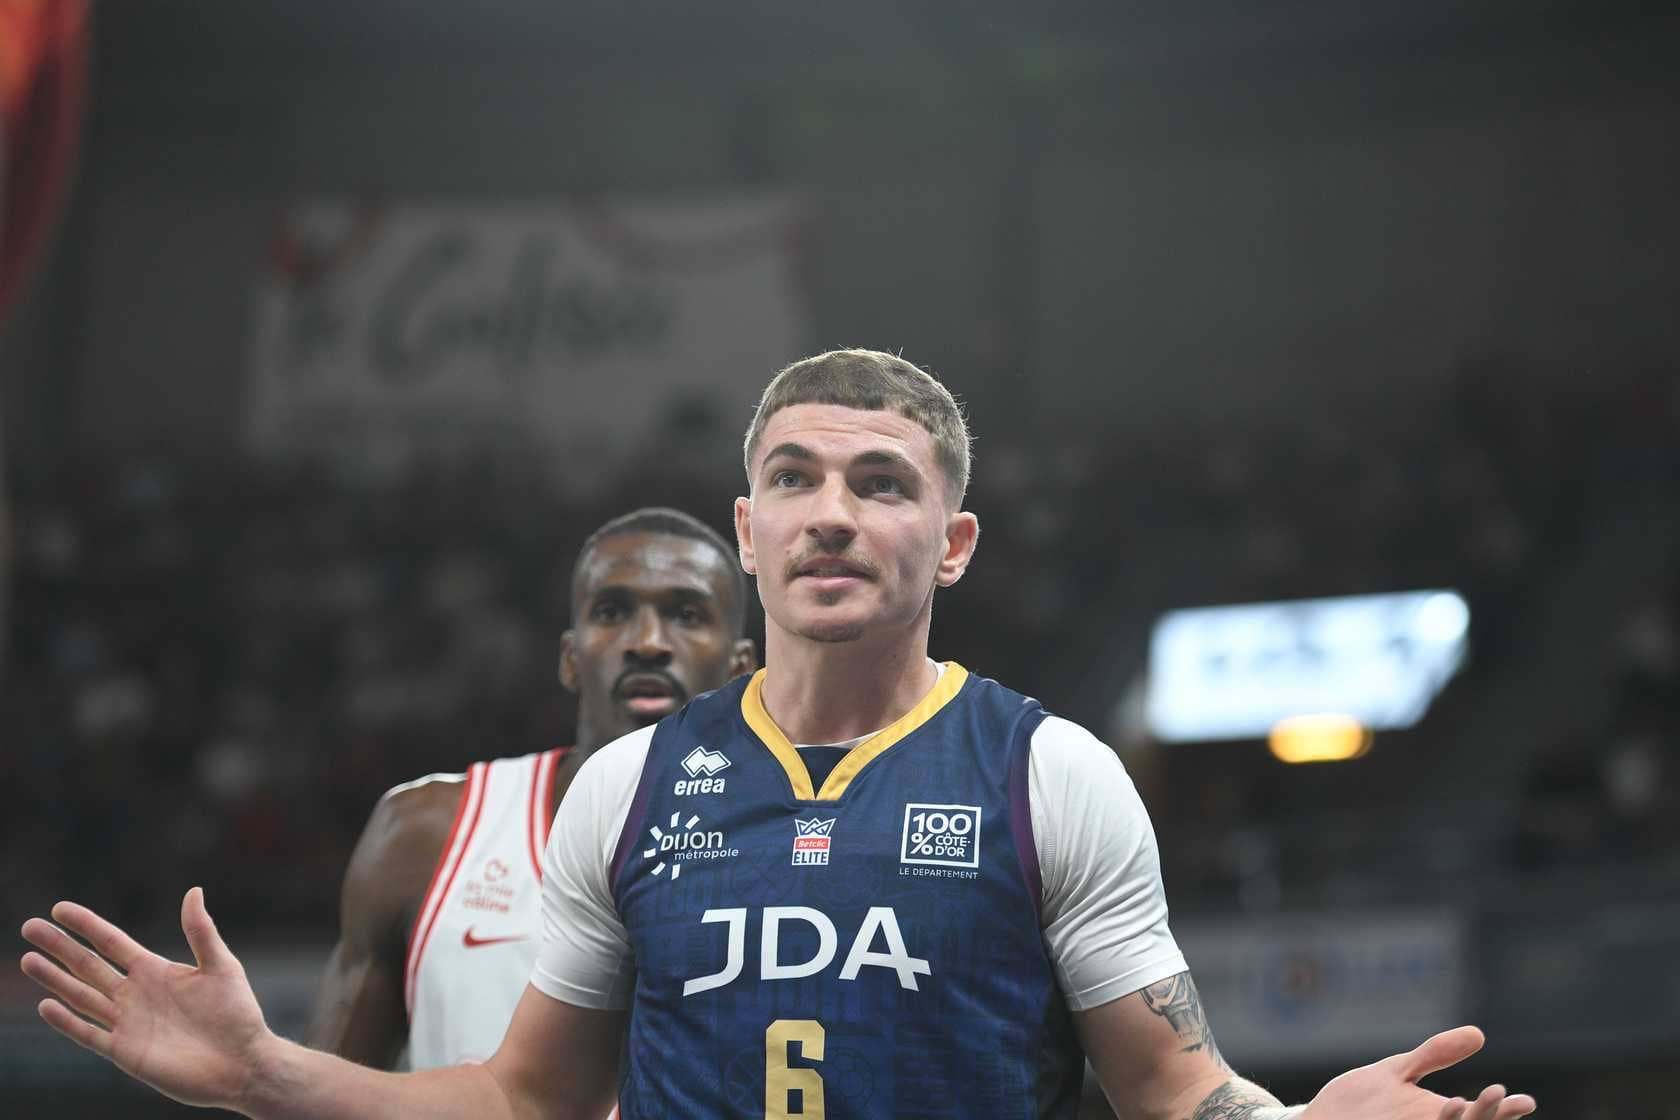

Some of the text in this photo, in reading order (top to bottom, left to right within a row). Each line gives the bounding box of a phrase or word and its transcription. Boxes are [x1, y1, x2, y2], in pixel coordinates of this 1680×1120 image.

[674, 778, 726, 796] errea
[913, 812, 972, 835] 100
[674, 848, 740, 860] métropole
[910, 832, 935, 856] %
[935, 845, 965, 858] D'OR
[899, 867, 910, 876] LE
[682, 906, 932, 997] JDA
[765, 1019, 826, 1120] 6
